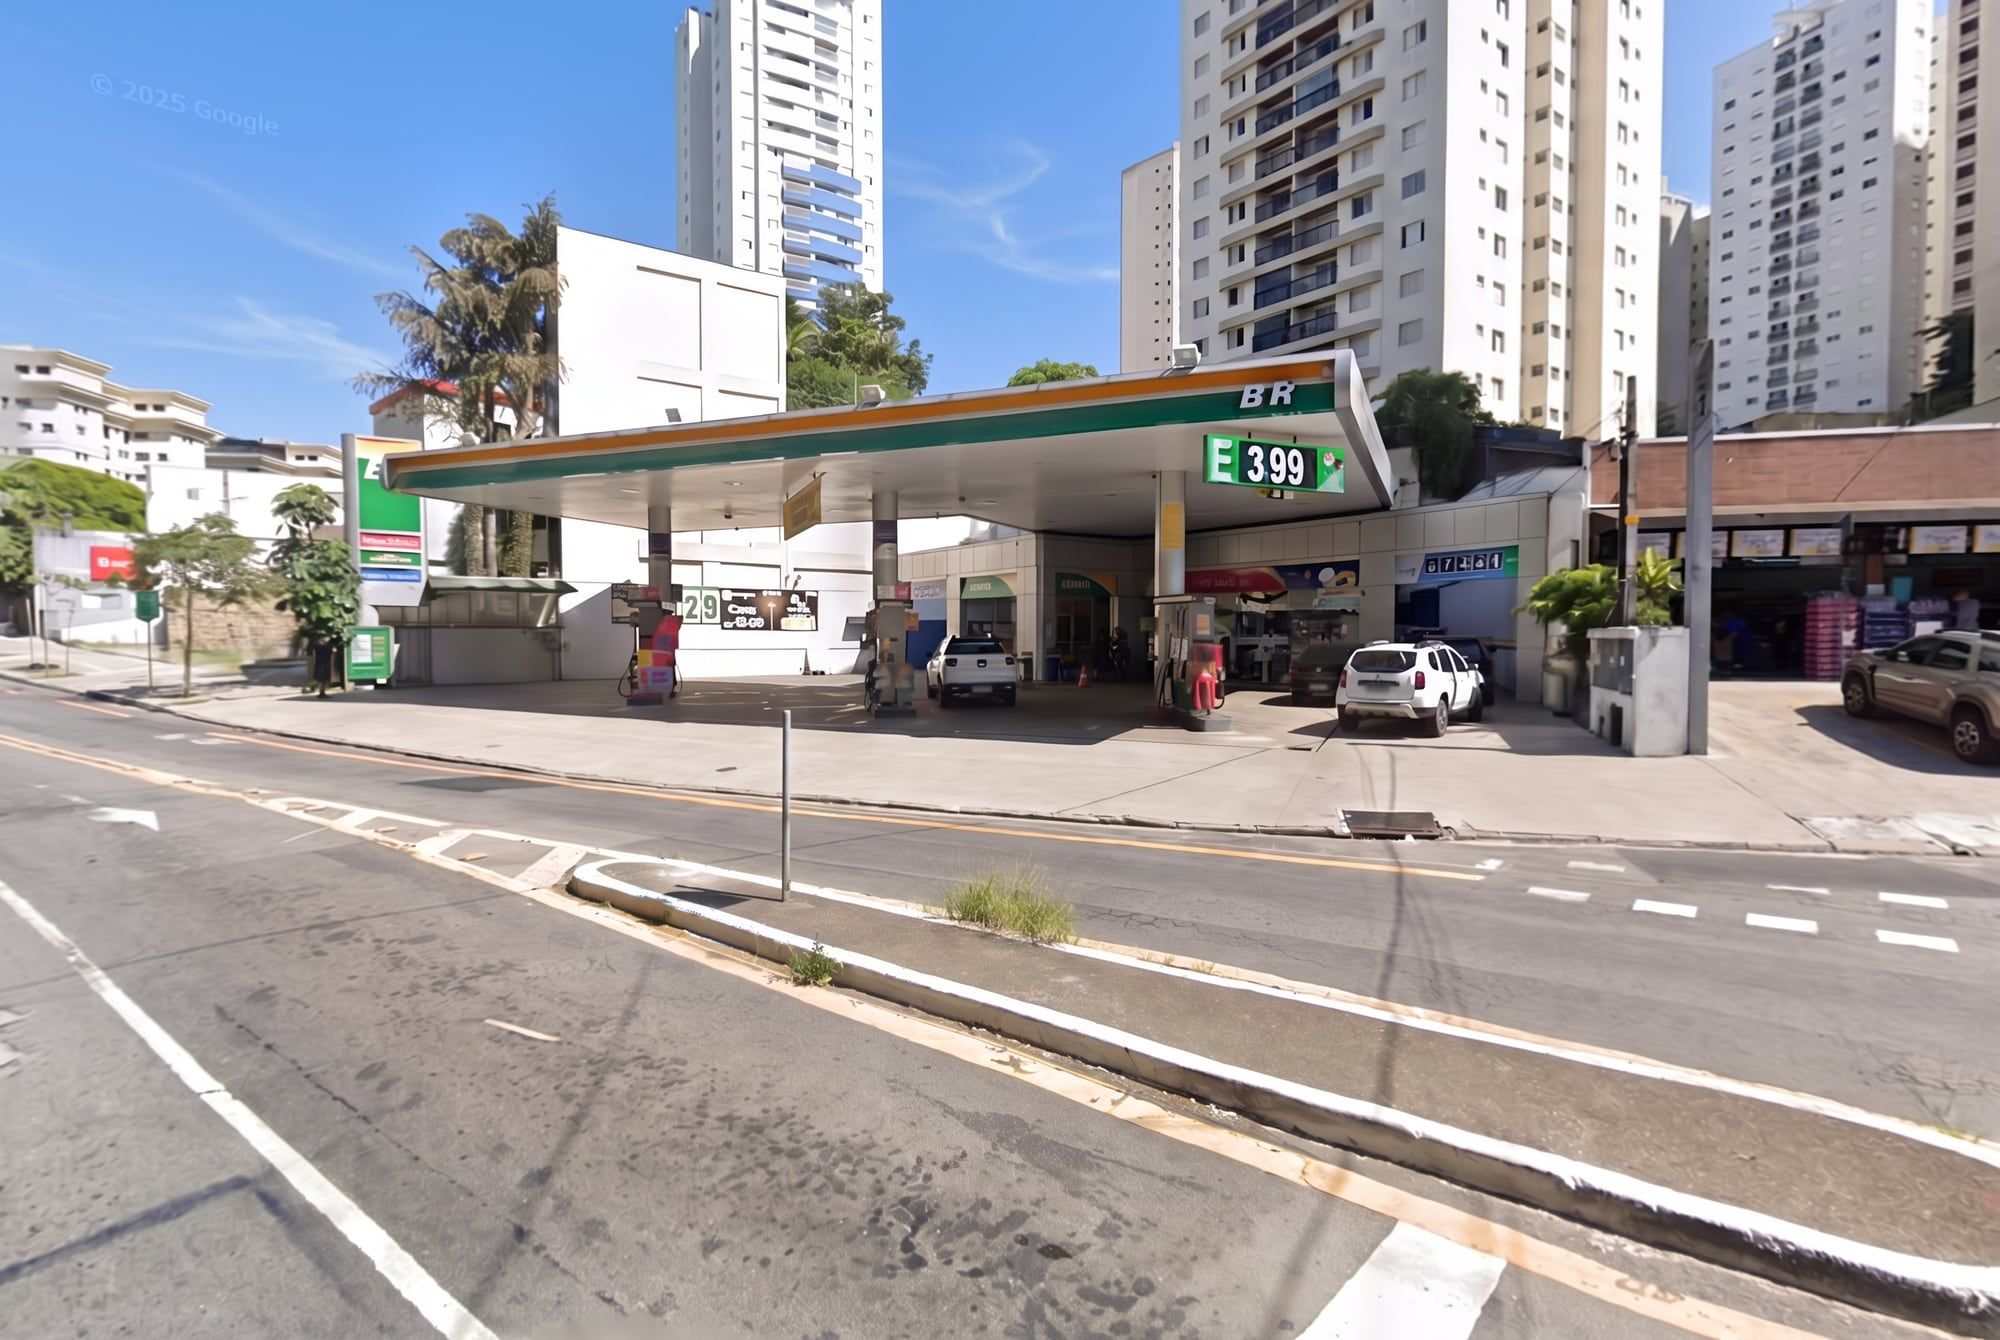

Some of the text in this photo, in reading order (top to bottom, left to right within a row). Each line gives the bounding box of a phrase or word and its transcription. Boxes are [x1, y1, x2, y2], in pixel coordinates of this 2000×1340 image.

[1240, 381, 1296, 409] BR
[1210, 438, 1233, 482] E
[685, 594, 718, 619] 29
